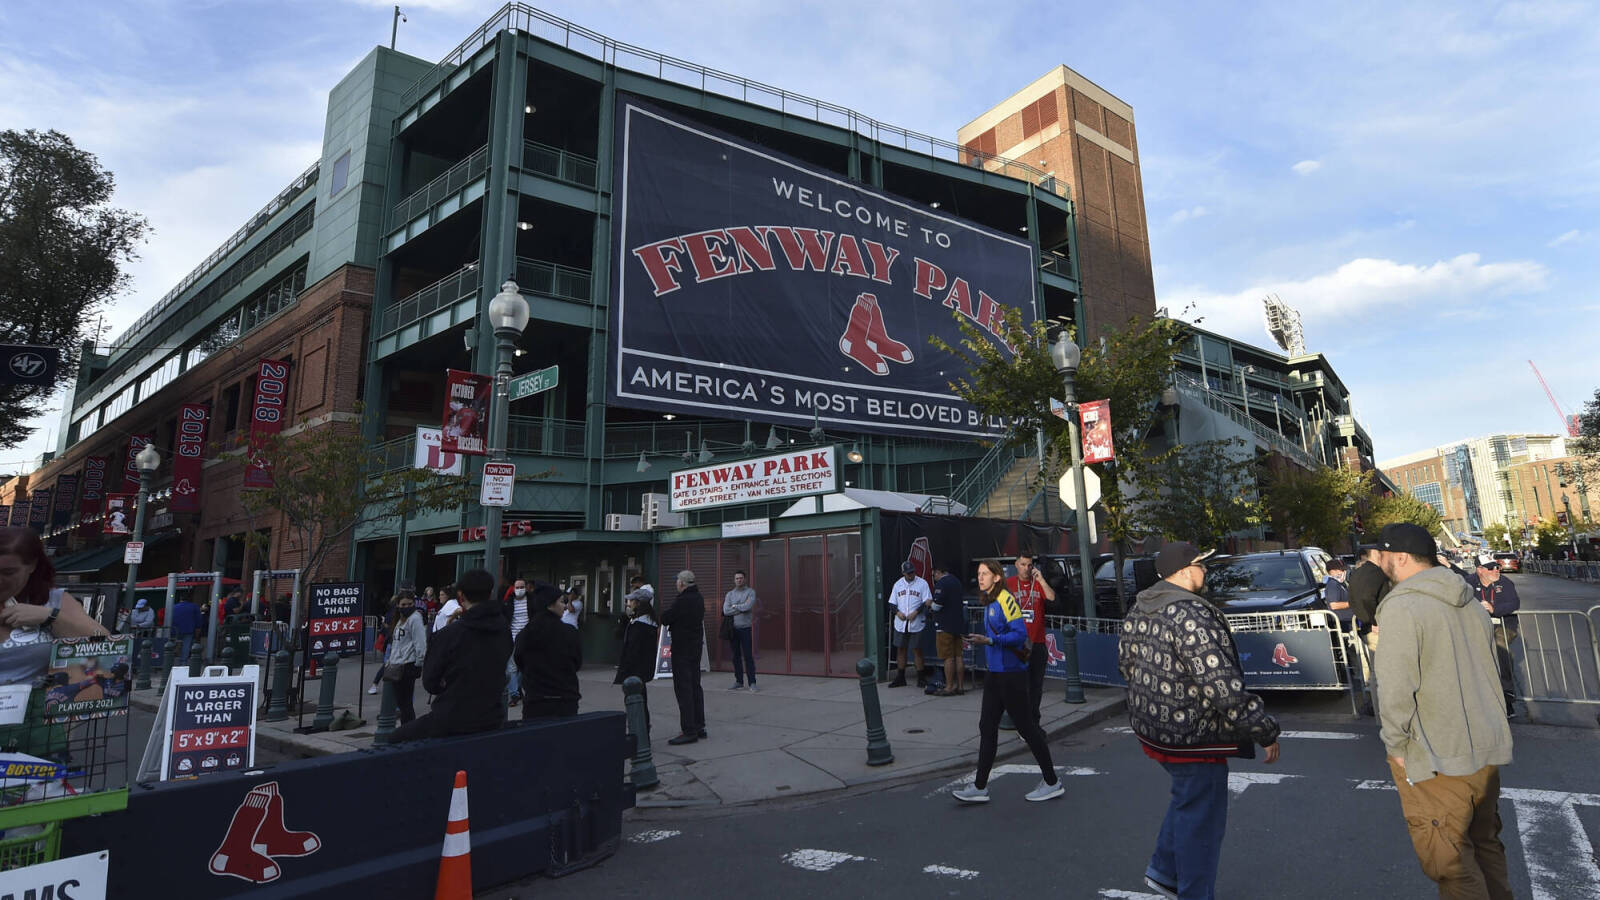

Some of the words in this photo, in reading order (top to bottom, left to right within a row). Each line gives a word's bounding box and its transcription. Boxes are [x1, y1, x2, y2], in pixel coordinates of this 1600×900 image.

[772, 176, 909, 238] WELCOME
[920, 227, 951, 248] TO
[632, 226, 900, 297] FENWAY
[255, 362, 286, 422] 2018
[516, 374, 544, 397] JERSEY
[630, 366, 785, 405] AMERICA'S
[795, 389, 859, 414] MOST
[867, 398, 962, 423] BELOVED
[180, 406, 204, 457] 2013
[427, 445, 456, 470] D
[83, 457, 104, 500] 2004
[674, 463, 757, 490] FENWAY
[763, 451, 829, 477] PARK
[673, 489, 690, 499] GATE
[692, 488, 697, 497] D
[699, 486, 723, 495] STAIRS
[730, 479, 770, 491] ENTRANCE
[773, 476, 787, 485] ALL
[790, 470, 832, 482] SECTIONS
[680, 497, 706, 507] JERSEY
[709, 493, 737, 503] STREET
[747, 489, 762, 497] VAN
[765, 486, 786, 495] NESS
[790, 481, 823, 493] STREET
[316, 588, 330, 597] NO
[333, 587, 359, 596] BAGS
[317, 597, 357, 606] LARGER
[324, 606, 350, 615] THAN
[75, 642, 115, 653] YAWKEY
[58, 700, 94, 712] PLAYOFFS
[96, 699, 113, 709] 2021
[184, 690, 204, 700] NO
[209, 688, 245, 699] BAGS
[186, 700, 242, 712] LARGER
[195, 713, 232, 724] THAN
[5, 764, 57, 777] BOSTON
